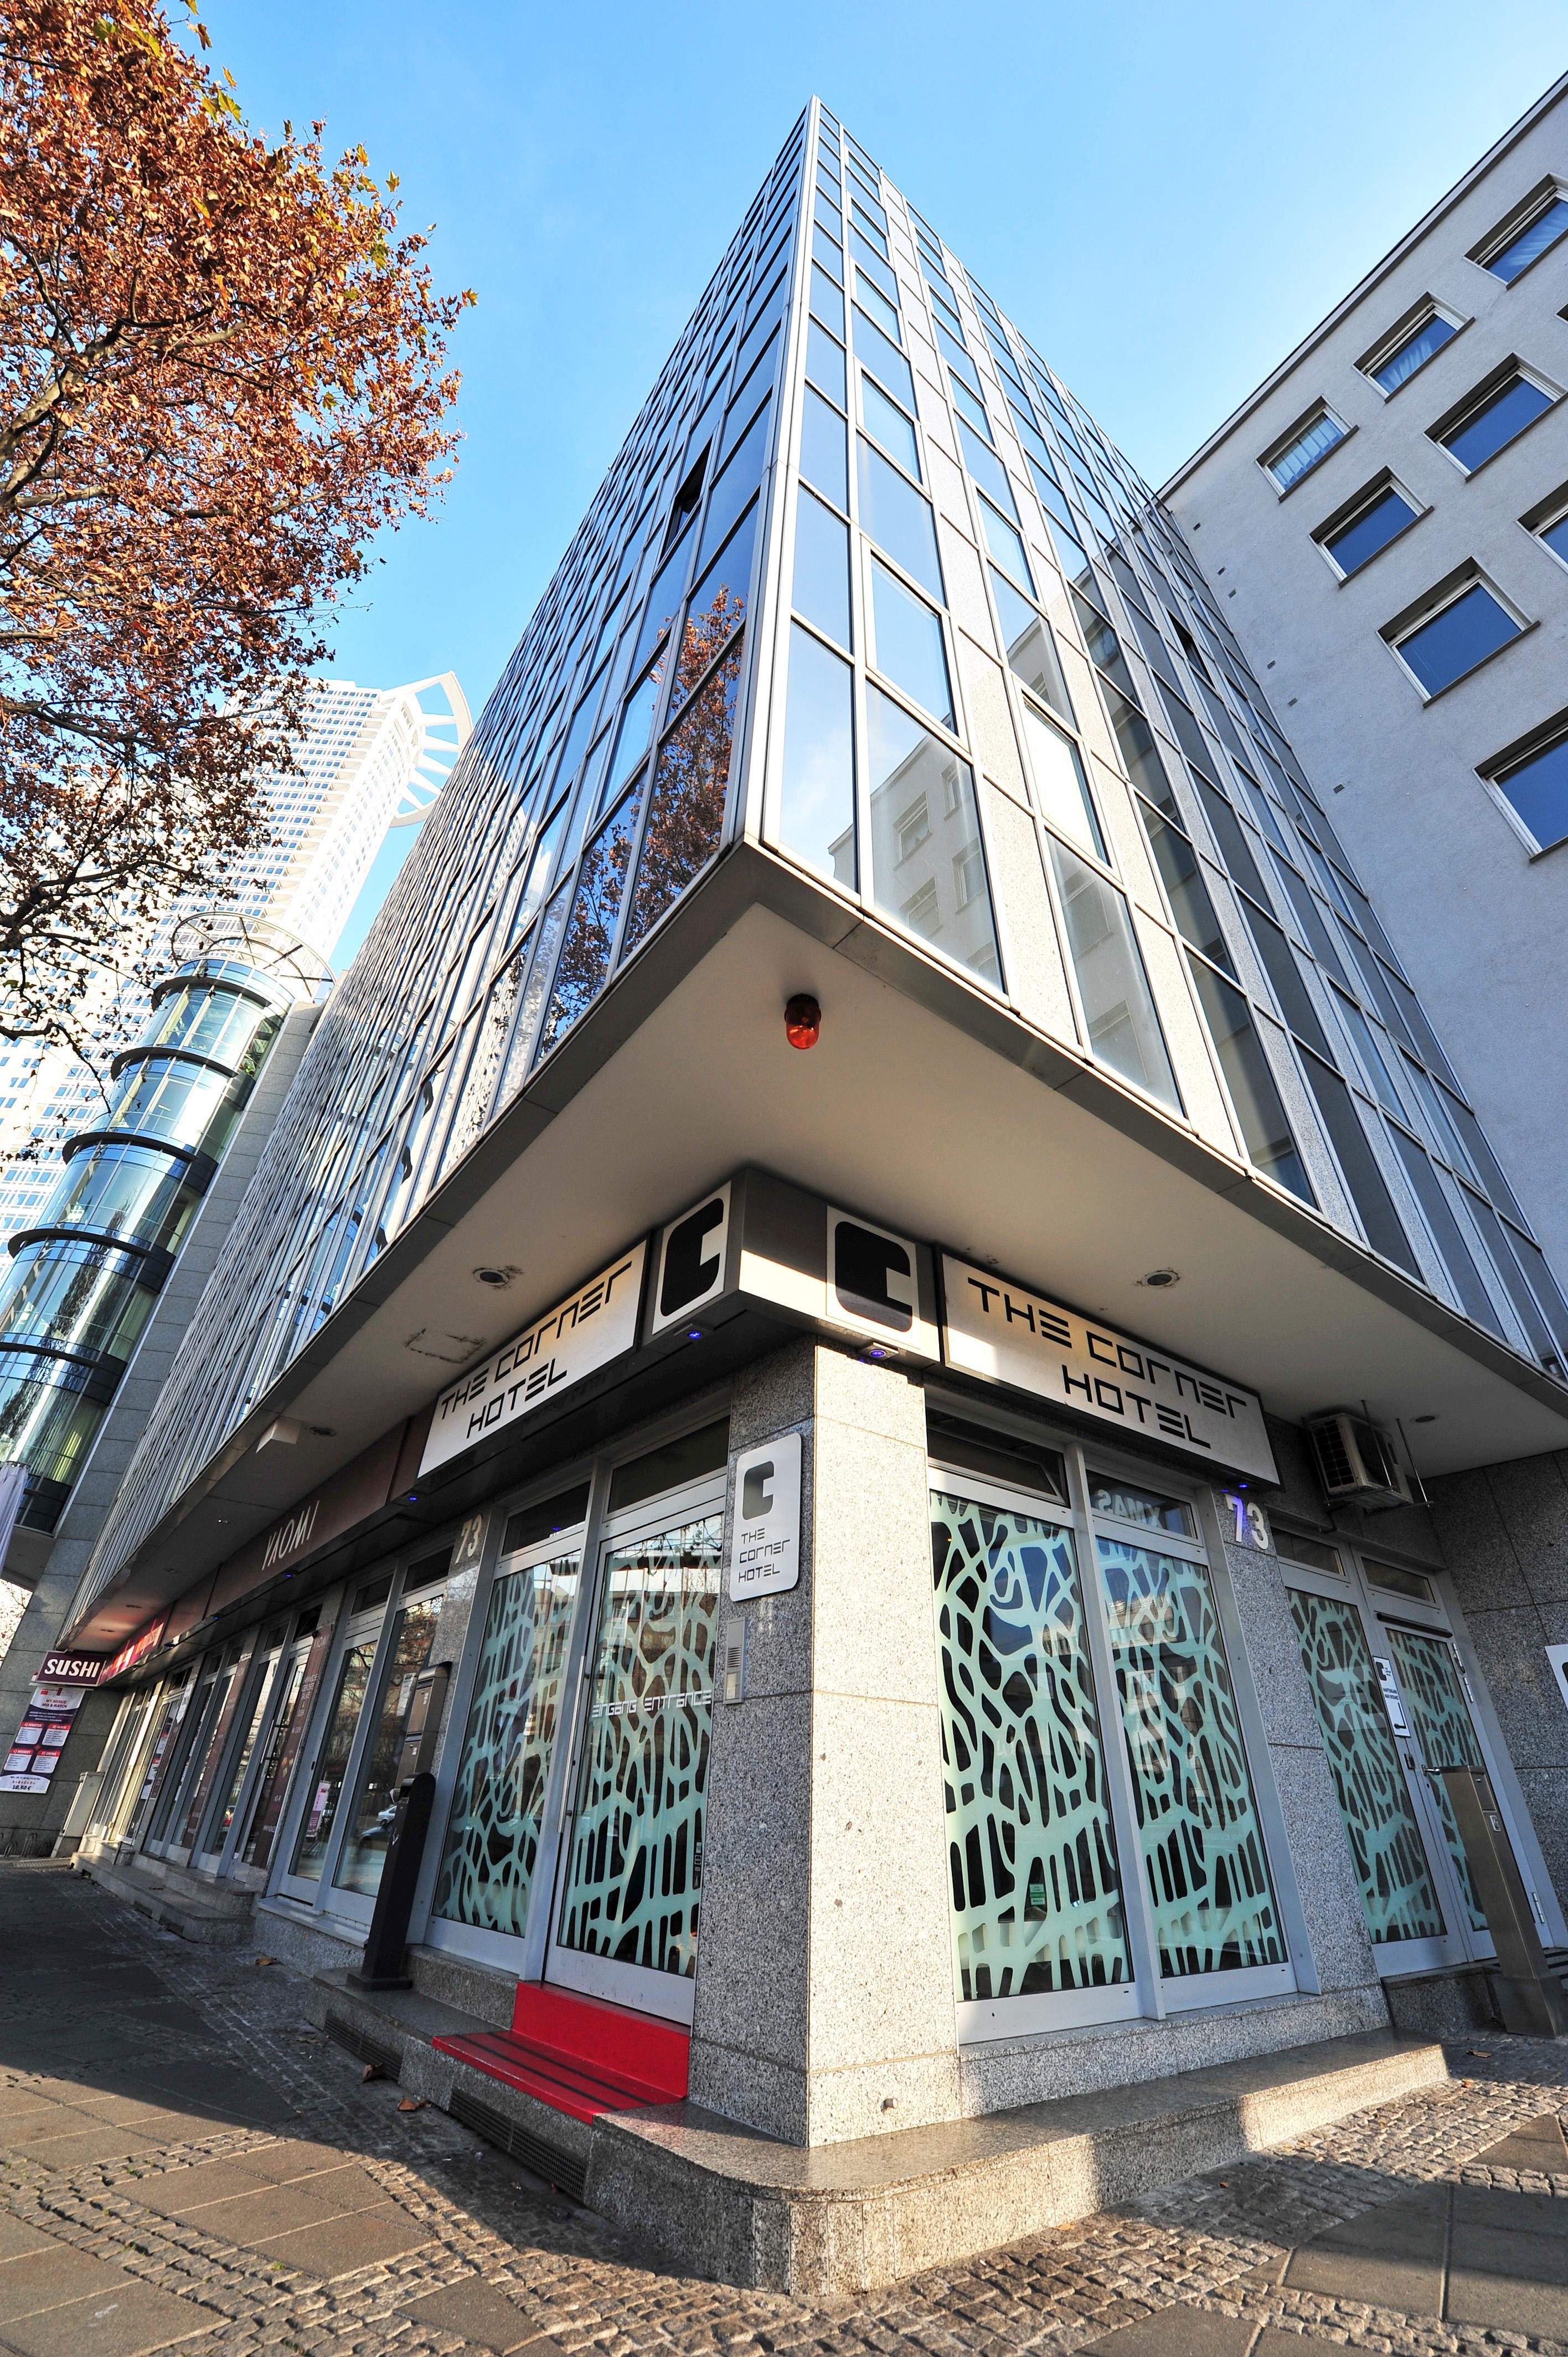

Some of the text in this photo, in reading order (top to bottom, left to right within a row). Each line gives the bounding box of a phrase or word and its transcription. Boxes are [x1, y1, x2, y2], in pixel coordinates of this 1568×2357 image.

[967, 1277, 1072, 1349] THE
[441, 1367, 489, 1420] THE
[466, 1358, 568, 1439] HOTEL
[1062, 1364, 1211, 1449] HOTEL
[454, 1514, 483, 1565] 73
[741, 1527, 765, 1545] THE
[1226, 1495, 1270, 1551] 73
[738, 1563, 781, 1584] HOTEL
[44, 1658, 101, 1678] SUSHI
